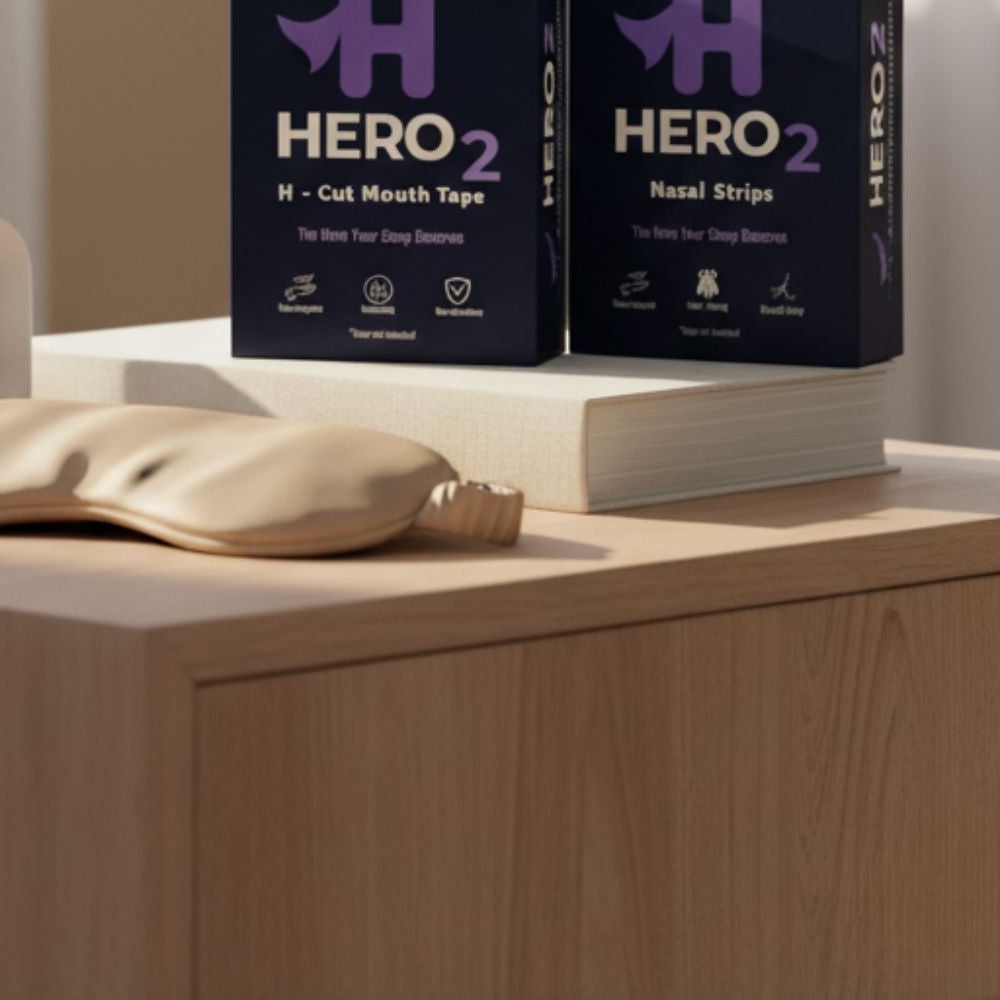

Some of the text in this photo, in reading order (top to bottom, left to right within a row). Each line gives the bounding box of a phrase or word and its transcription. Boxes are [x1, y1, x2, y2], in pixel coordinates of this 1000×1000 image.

[278, 184, 293, 201] H
[317, 185, 354, 203] Cut
[362, 184, 431, 204] Mouth
[435, 186, 485, 209] Tape
[650, 181, 774, 206] Nasal Strips
